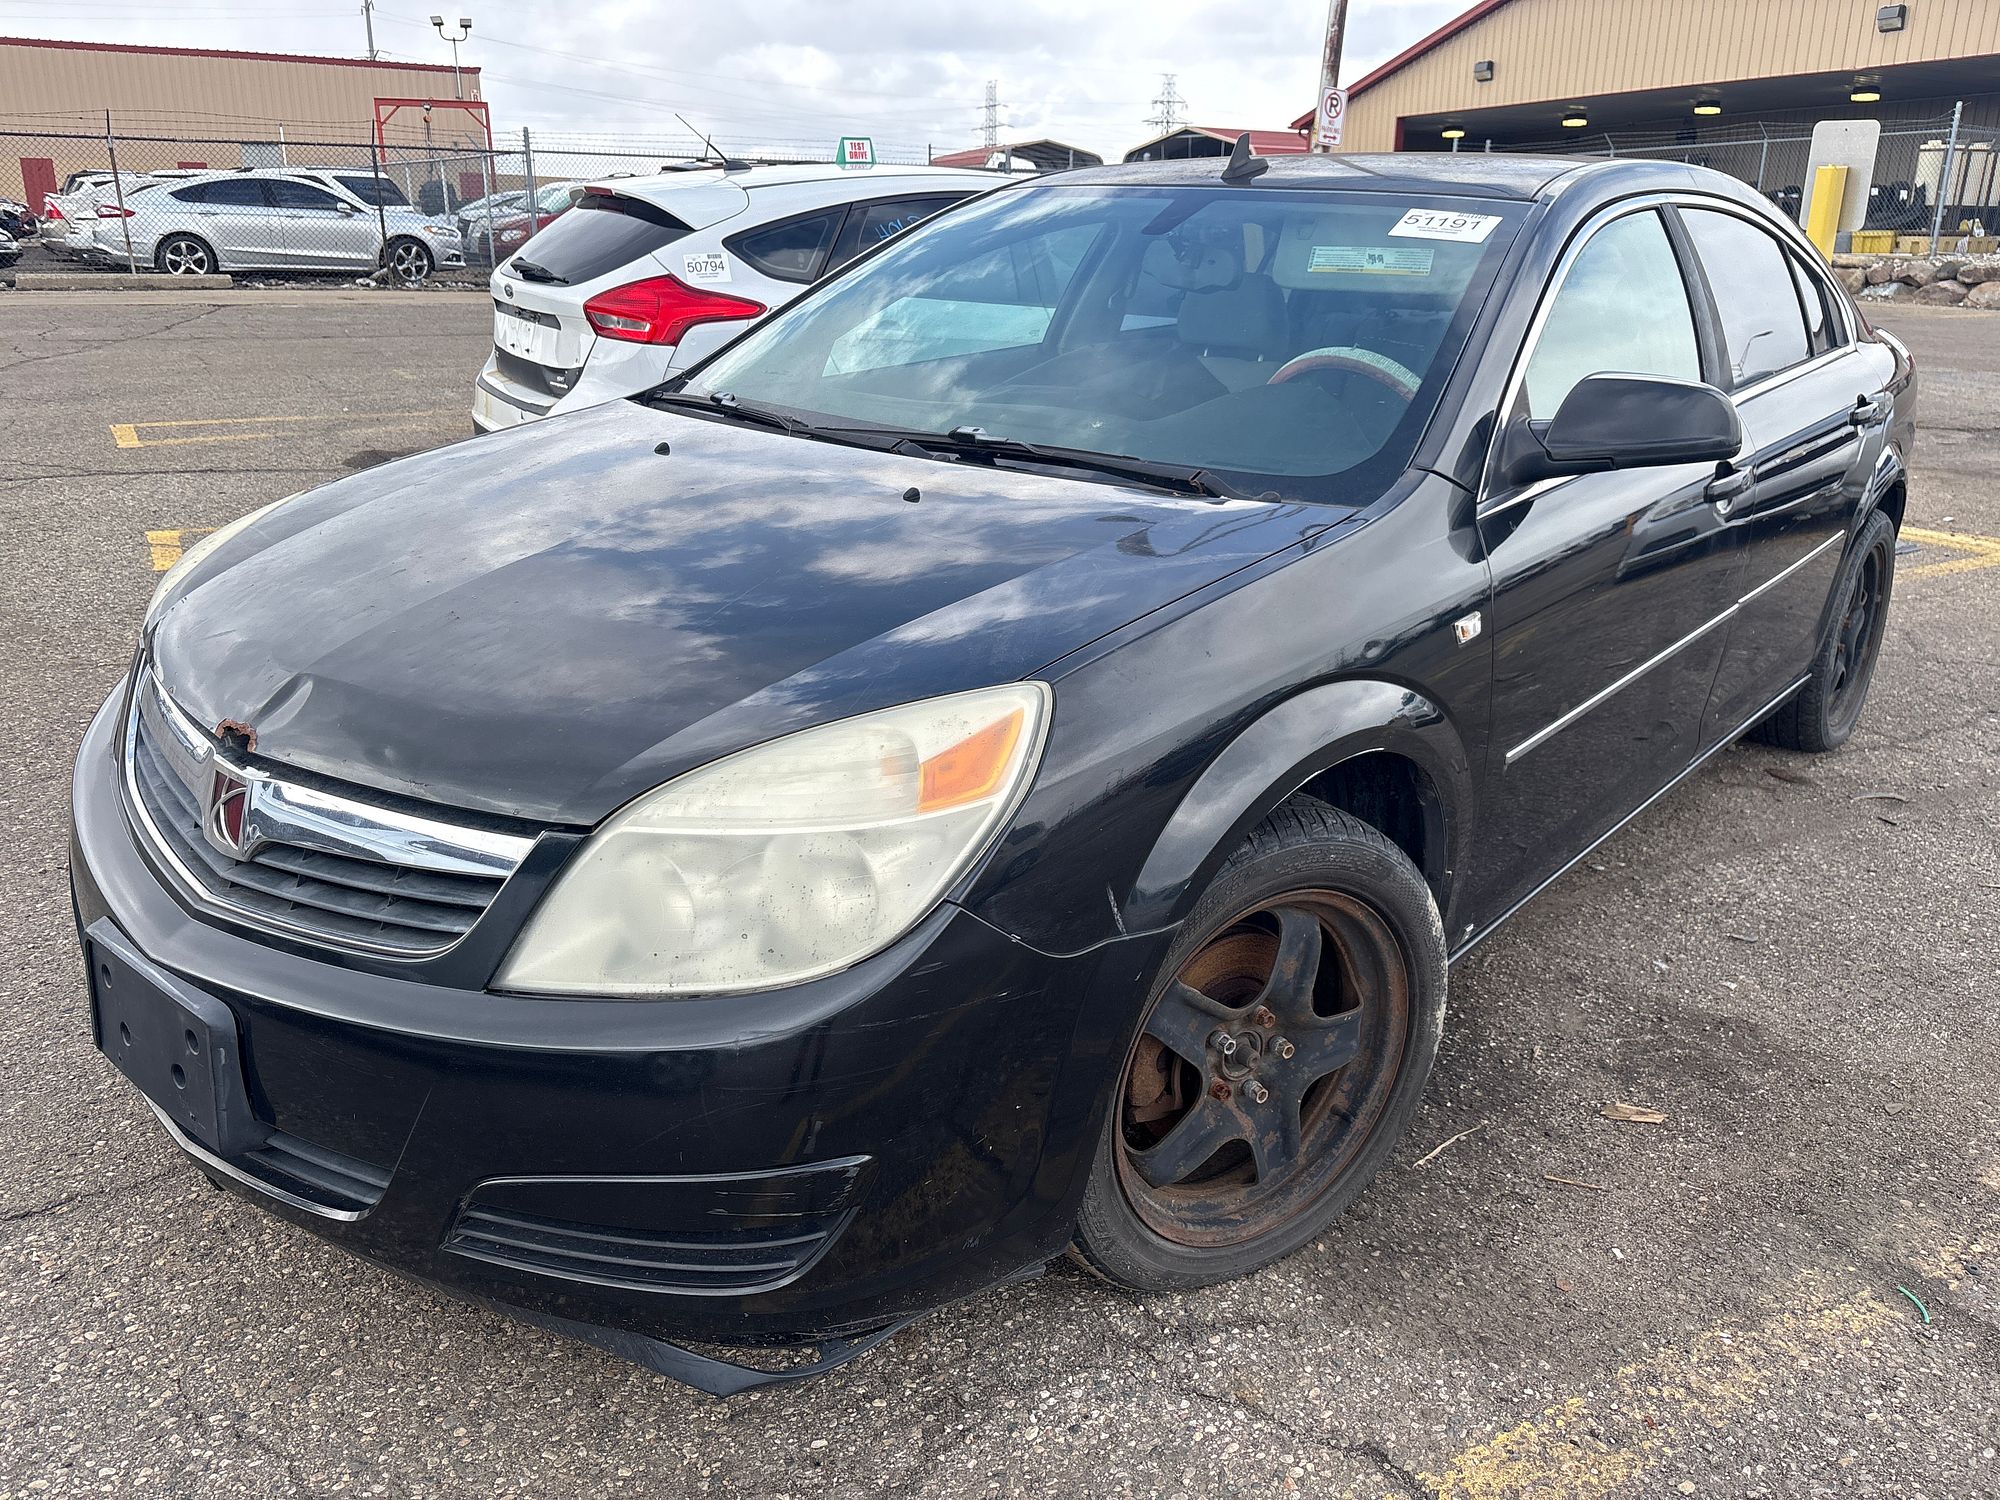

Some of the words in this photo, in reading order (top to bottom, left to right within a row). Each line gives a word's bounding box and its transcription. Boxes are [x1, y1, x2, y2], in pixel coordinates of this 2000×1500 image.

[849, 142, 865, 151] TEST
[849, 151, 868, 160] DRIVE
[1403, 214, 1482, 230] 51191
[687, 260, 725, 273] 50794
